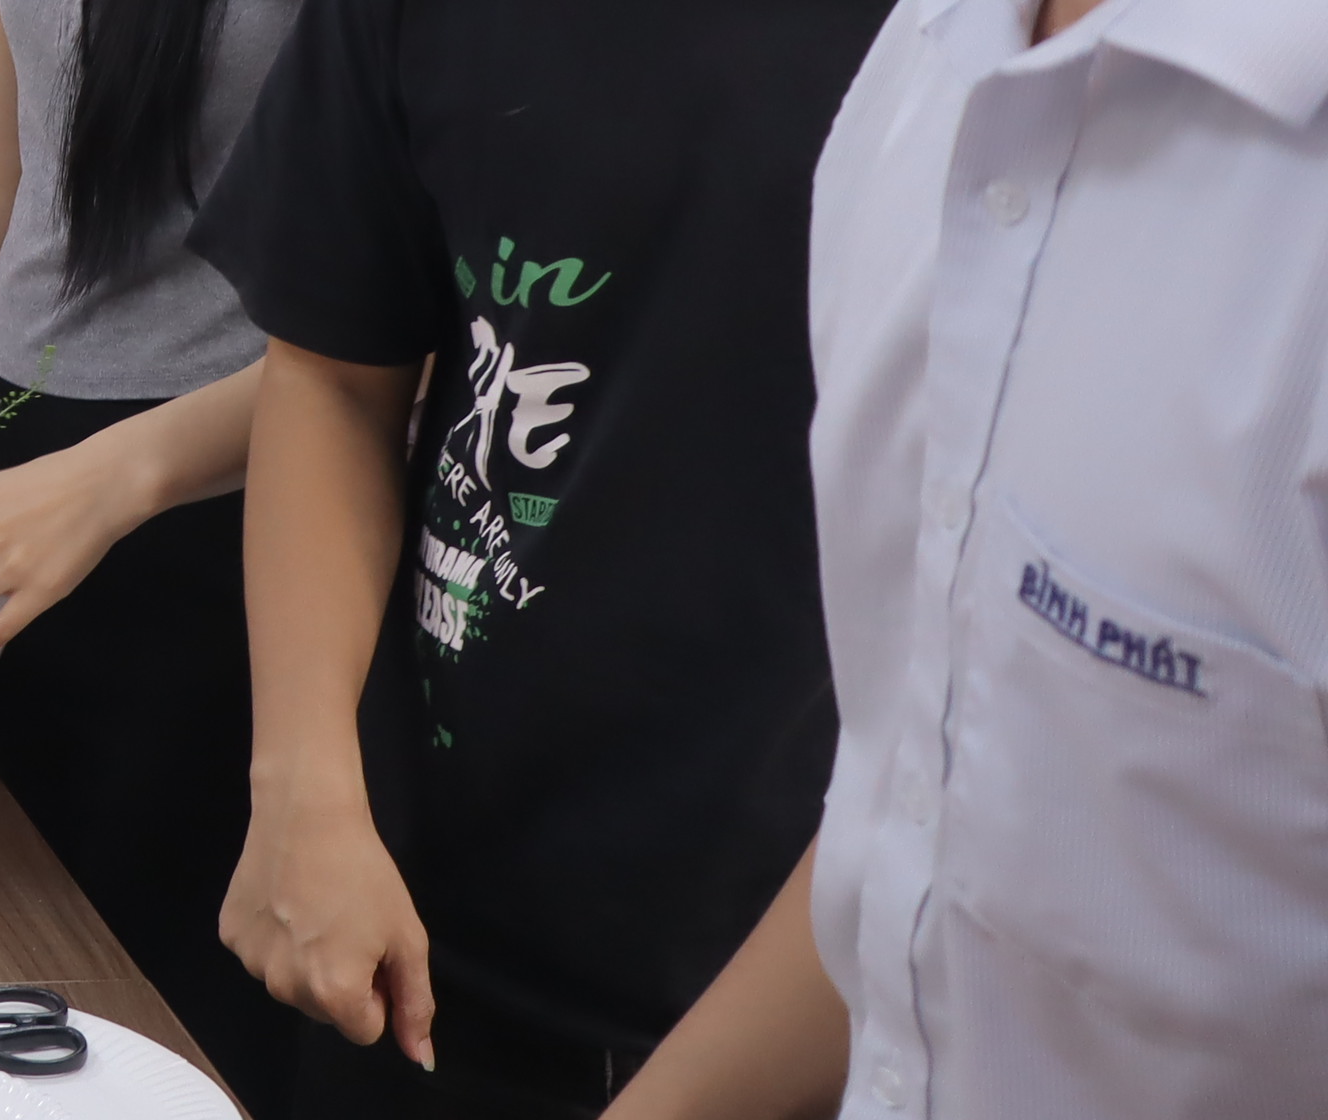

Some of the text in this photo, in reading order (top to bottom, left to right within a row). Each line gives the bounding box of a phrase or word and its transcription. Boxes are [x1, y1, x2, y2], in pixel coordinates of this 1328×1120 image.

[469, 500, 511, 558] ARE
[1018, 558, 1203, 691] BÌNH PHÁT
